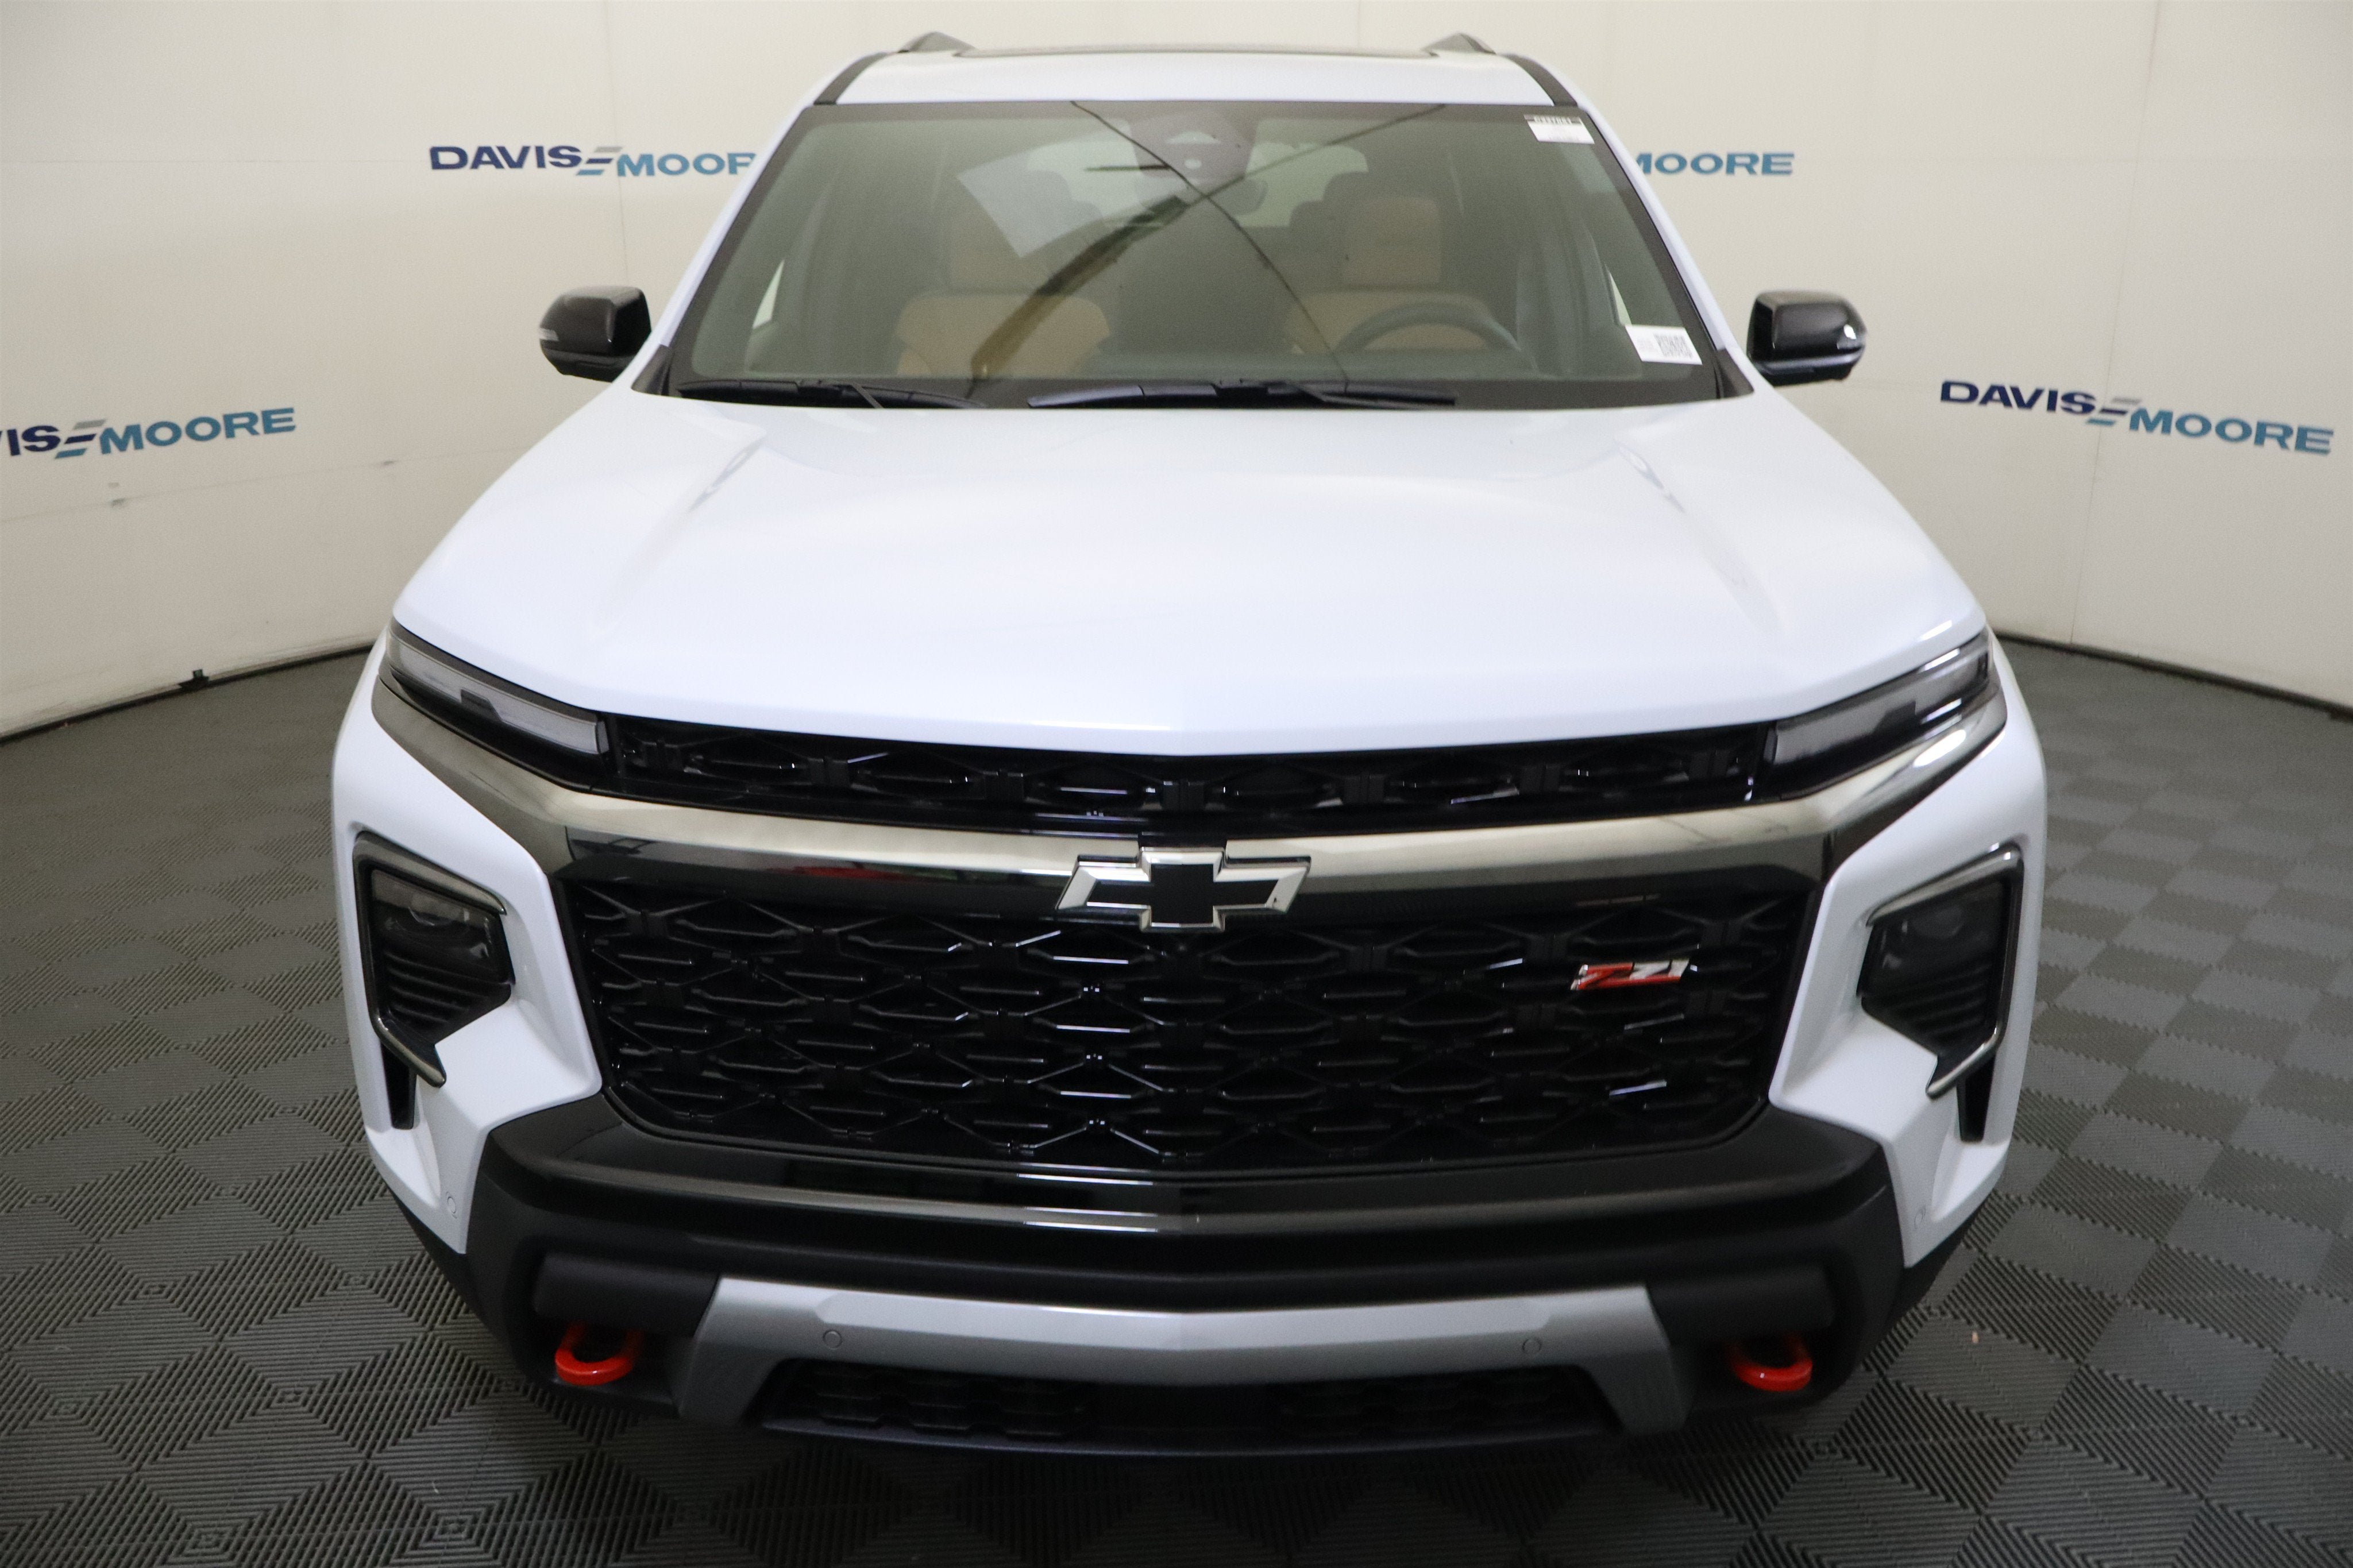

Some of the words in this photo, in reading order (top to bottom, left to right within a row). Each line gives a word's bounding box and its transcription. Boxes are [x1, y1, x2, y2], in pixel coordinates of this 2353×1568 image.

[430, 145, 582, 170] DAVIS
[99, 407, 296, 455] MOORE
[1940, 379, 2096, 414] DAVIS
[2129, 407, 2335, 456] MOORE
[1570, 958, 1689, 990] Z71
